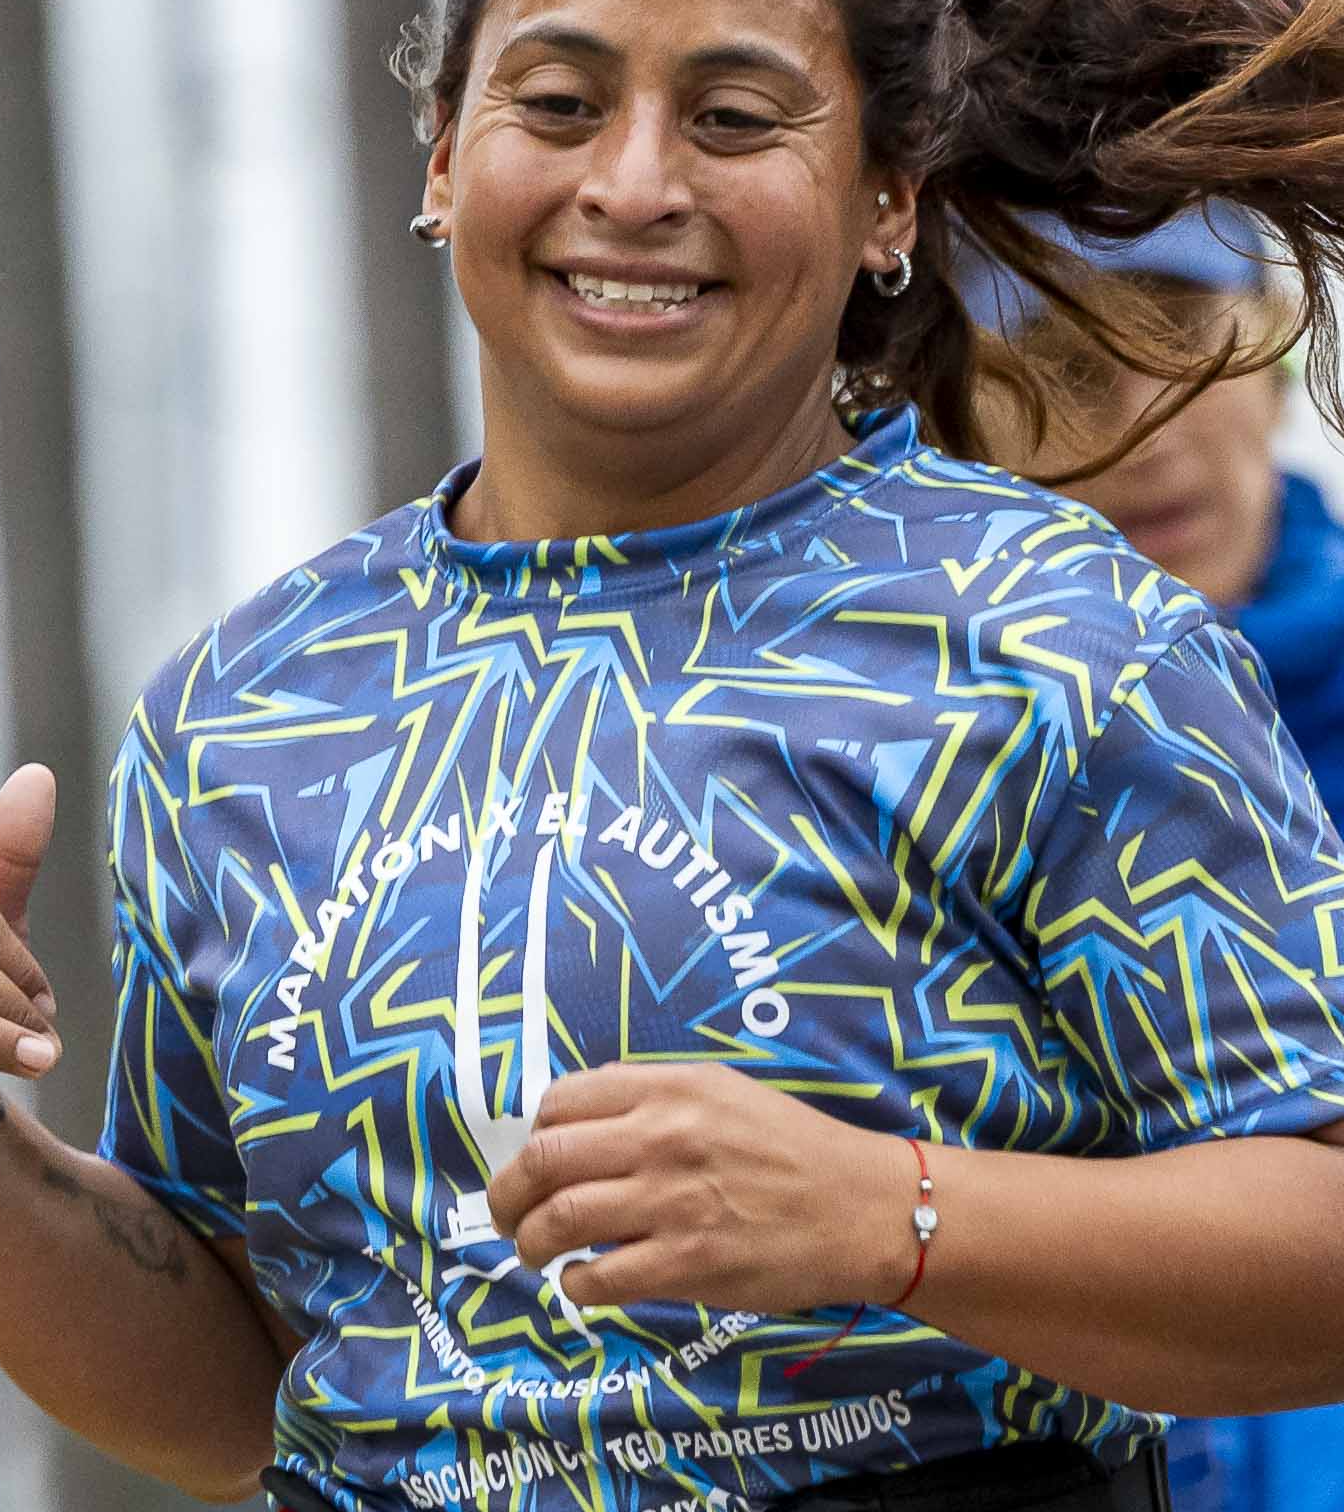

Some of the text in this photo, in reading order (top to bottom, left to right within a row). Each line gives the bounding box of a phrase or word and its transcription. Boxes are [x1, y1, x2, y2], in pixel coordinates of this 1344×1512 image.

[267, 792, 790, 1072] MARATÓN X EL AUTISMO
[655, 1354, 674, 1381] Y
[606, 1432, 667, 1473] TGD
[672, 1423, 793, 1459] PADRES
[799, 1389, 911, 1453] UNIDOS
